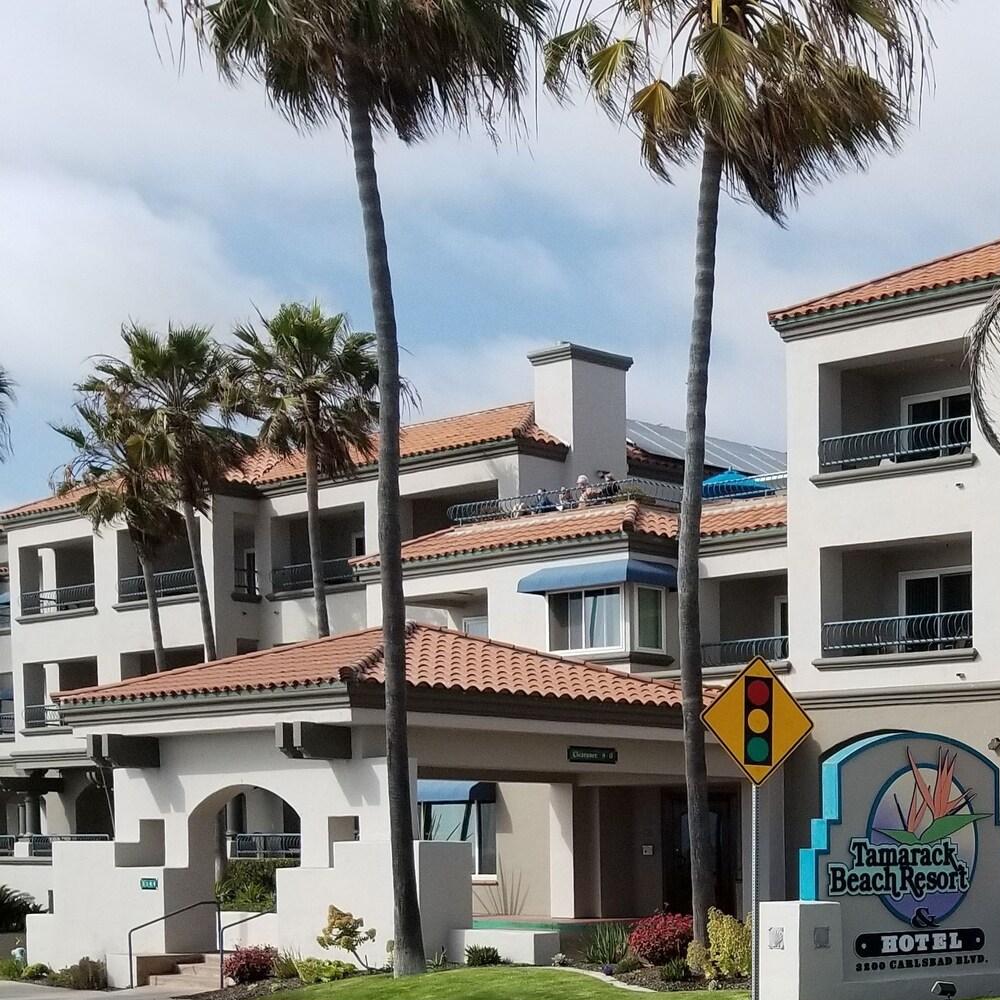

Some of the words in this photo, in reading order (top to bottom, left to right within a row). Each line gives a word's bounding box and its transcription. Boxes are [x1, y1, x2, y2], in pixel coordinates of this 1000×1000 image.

[851, 840, 964, 872] Tamarack
[829, 866, 902, 898] Beach
[899, 864, 969, 899] Resort
[911, 907, 941, 929] &
[880, 932, 963, 954] HOTEL
[855, 961, 886, 972] 3200
[889, 955, 953, 970] CARLSBAD
